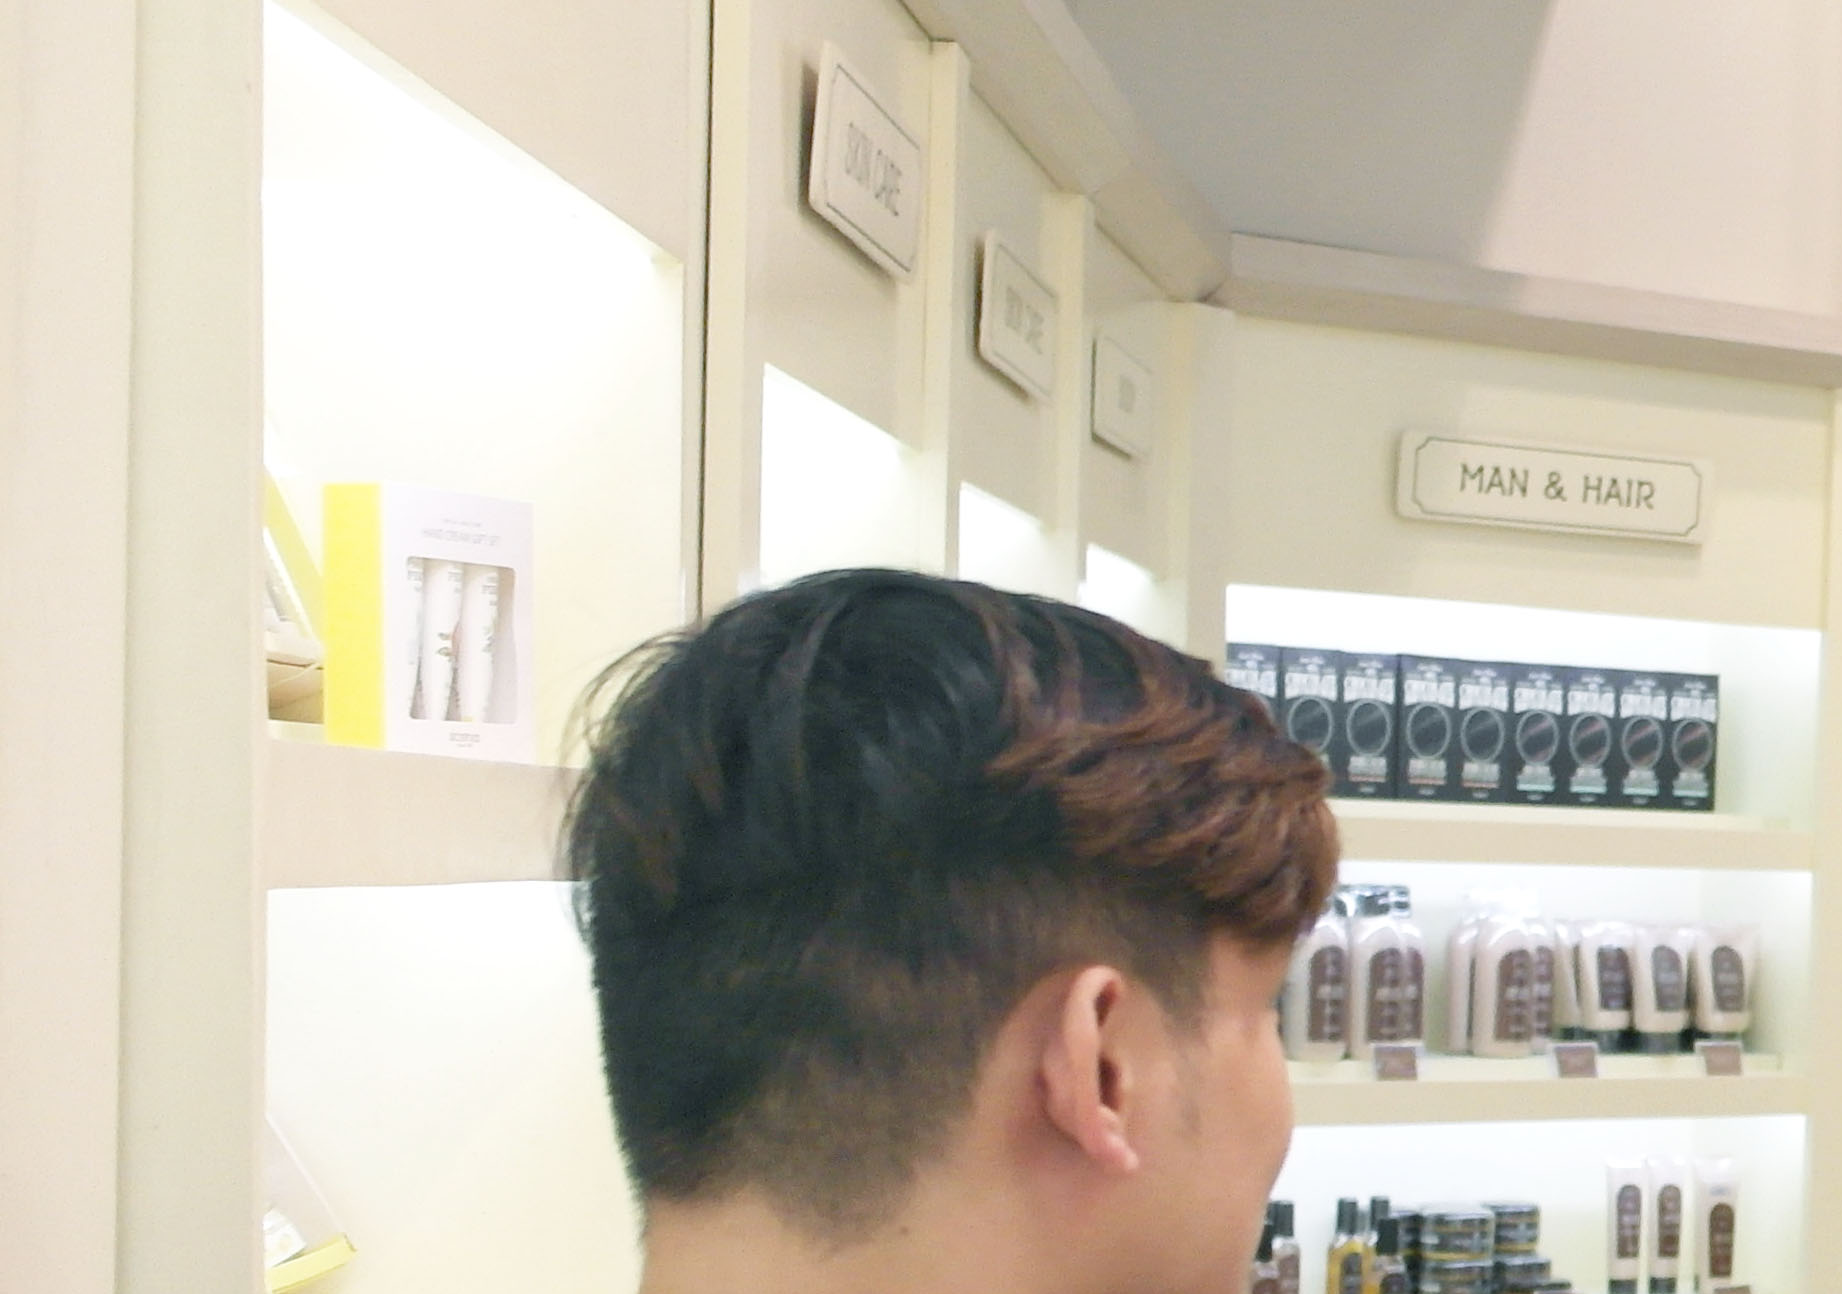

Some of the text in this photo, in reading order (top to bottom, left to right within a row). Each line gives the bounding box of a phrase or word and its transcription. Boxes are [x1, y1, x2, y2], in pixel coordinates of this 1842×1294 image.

[1459, 462, 1656, 510] MAN & HAIR
